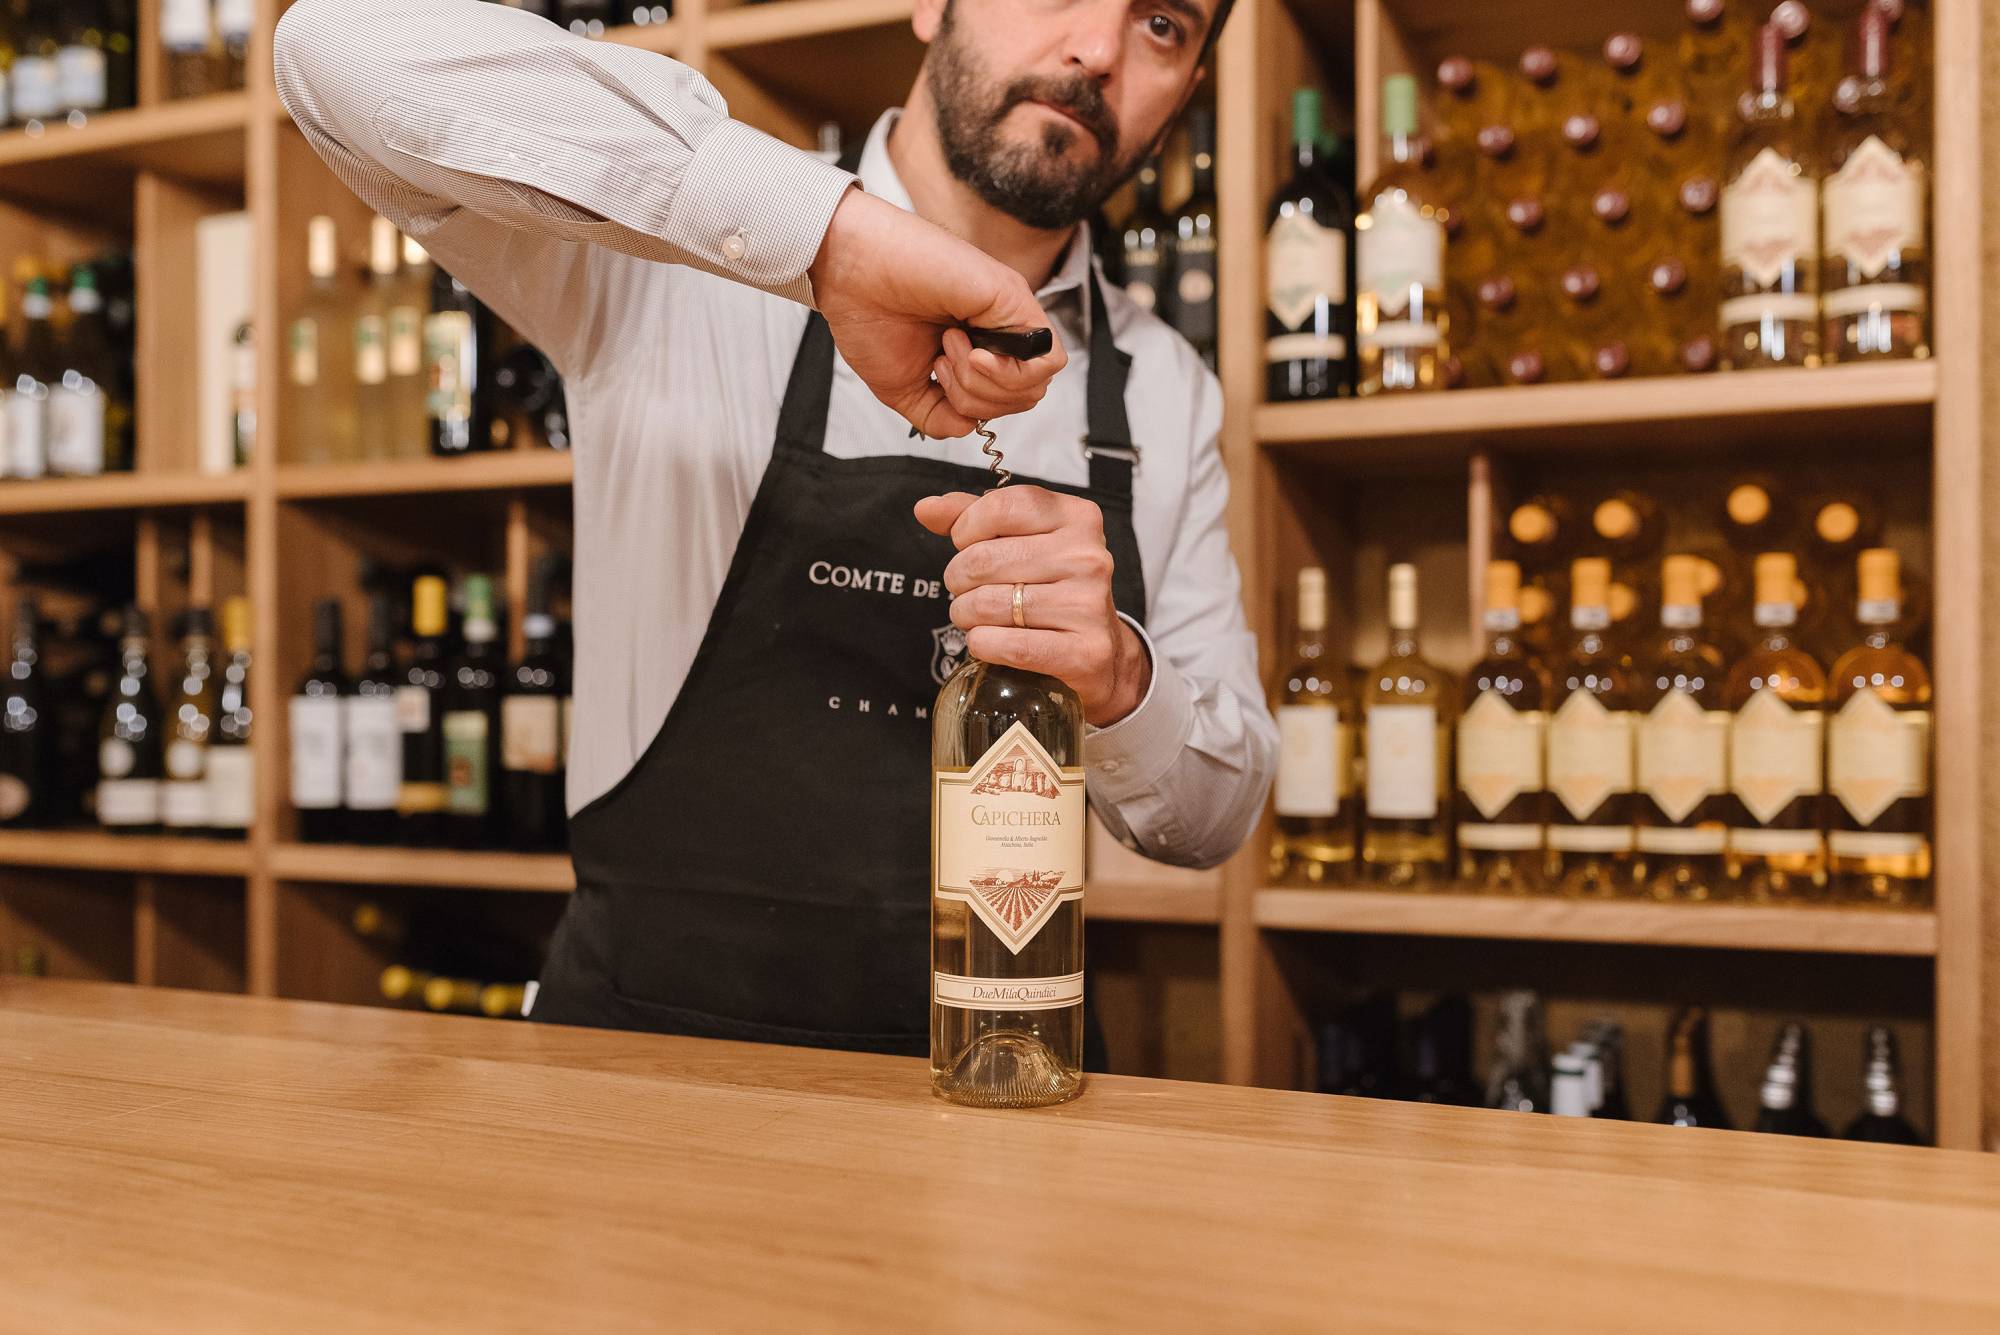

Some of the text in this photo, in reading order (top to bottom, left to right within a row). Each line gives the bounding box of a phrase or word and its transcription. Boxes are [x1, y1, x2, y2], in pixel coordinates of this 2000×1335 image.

[808, 560, 941, 599] COMTE DE
[828, 695, 928, 719] CHAM
[971, 805, 1061, 825] CAPICHERA
[972, 986, 1056, 1001] DueMilaQuindici
